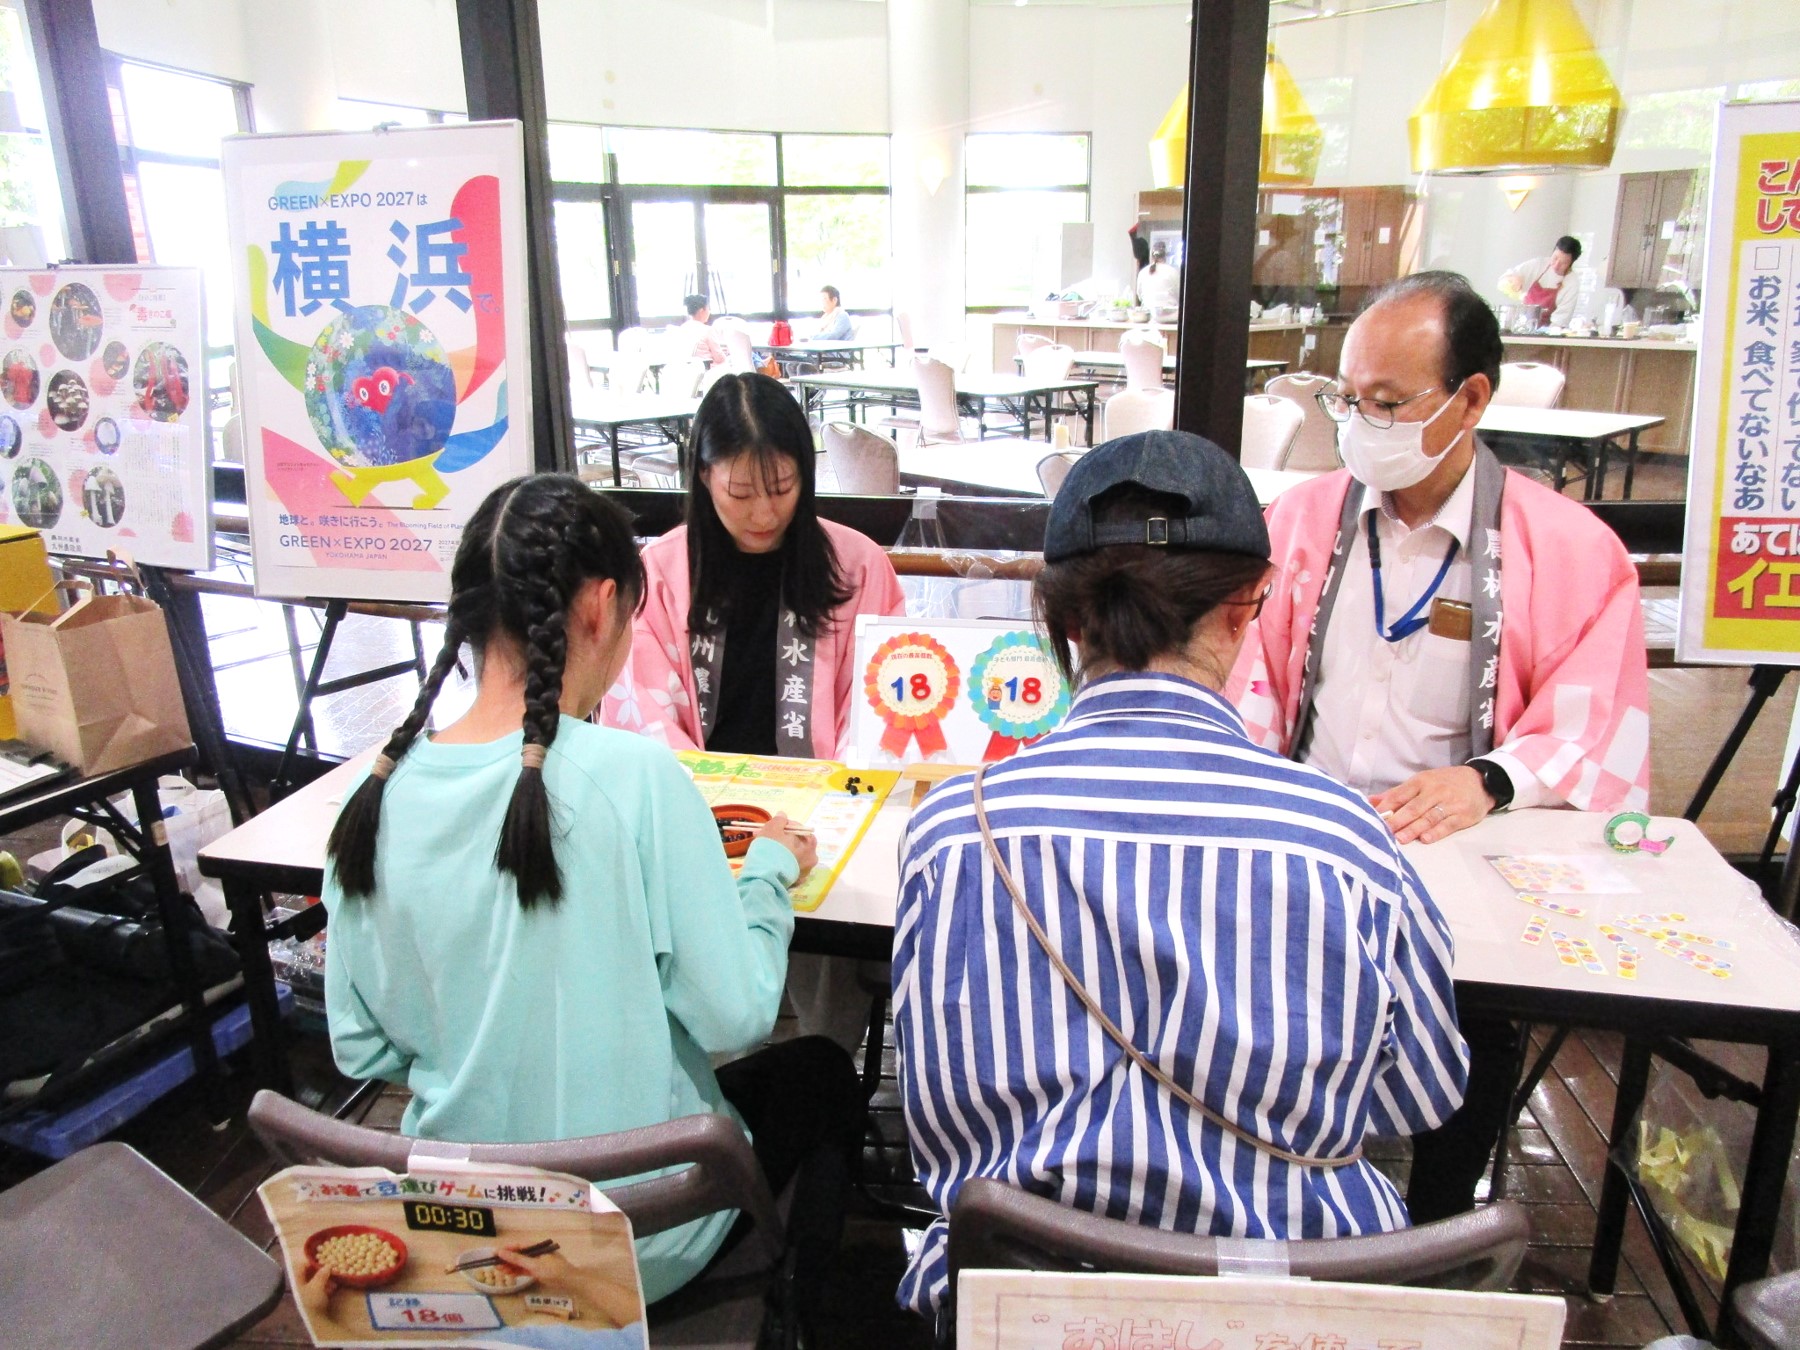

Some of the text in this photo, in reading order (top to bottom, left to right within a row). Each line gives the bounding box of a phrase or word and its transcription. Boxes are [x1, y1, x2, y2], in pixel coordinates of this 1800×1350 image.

[1733, 275, 1783, 511] お米、食べてないなあ
[325, 552, 365, 560] YOKOHAMA
[389, 537, 433, 552] 2027
[890, 672, 932, 703] 18
[1004, 676, 1042, 704] 18
[414, 1203, 485, 1231] 00:30
